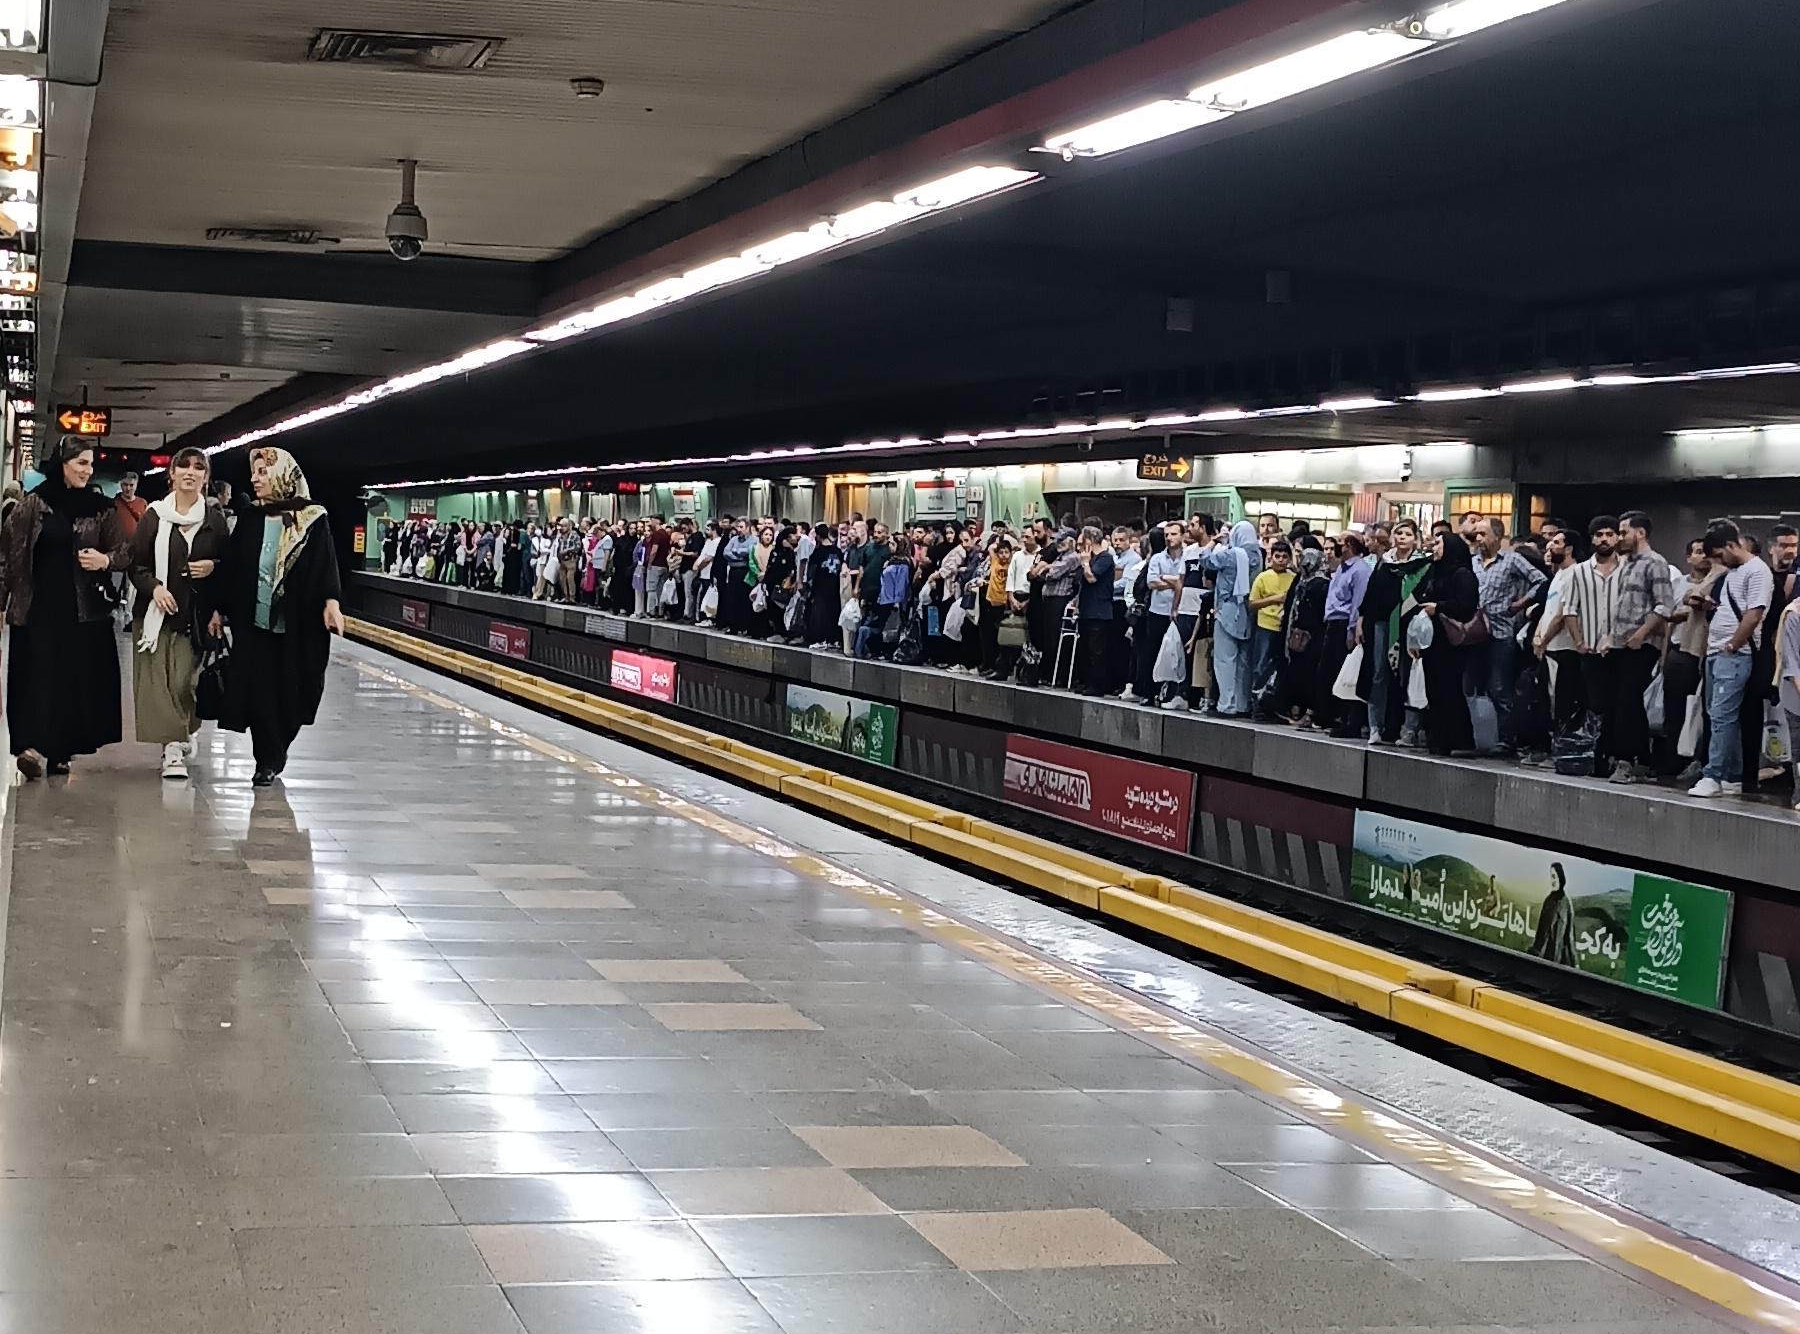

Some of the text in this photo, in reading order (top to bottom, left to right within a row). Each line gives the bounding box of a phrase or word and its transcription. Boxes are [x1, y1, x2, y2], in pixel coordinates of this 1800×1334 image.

[81, 420, 107, 433] EXIT
[1143, 453, 1168, 464] خروج
[1143, 466, 1168, 477] EXIT
[1442, 889, 1468, 924] این
[1602, 933, 1621, 969] به
